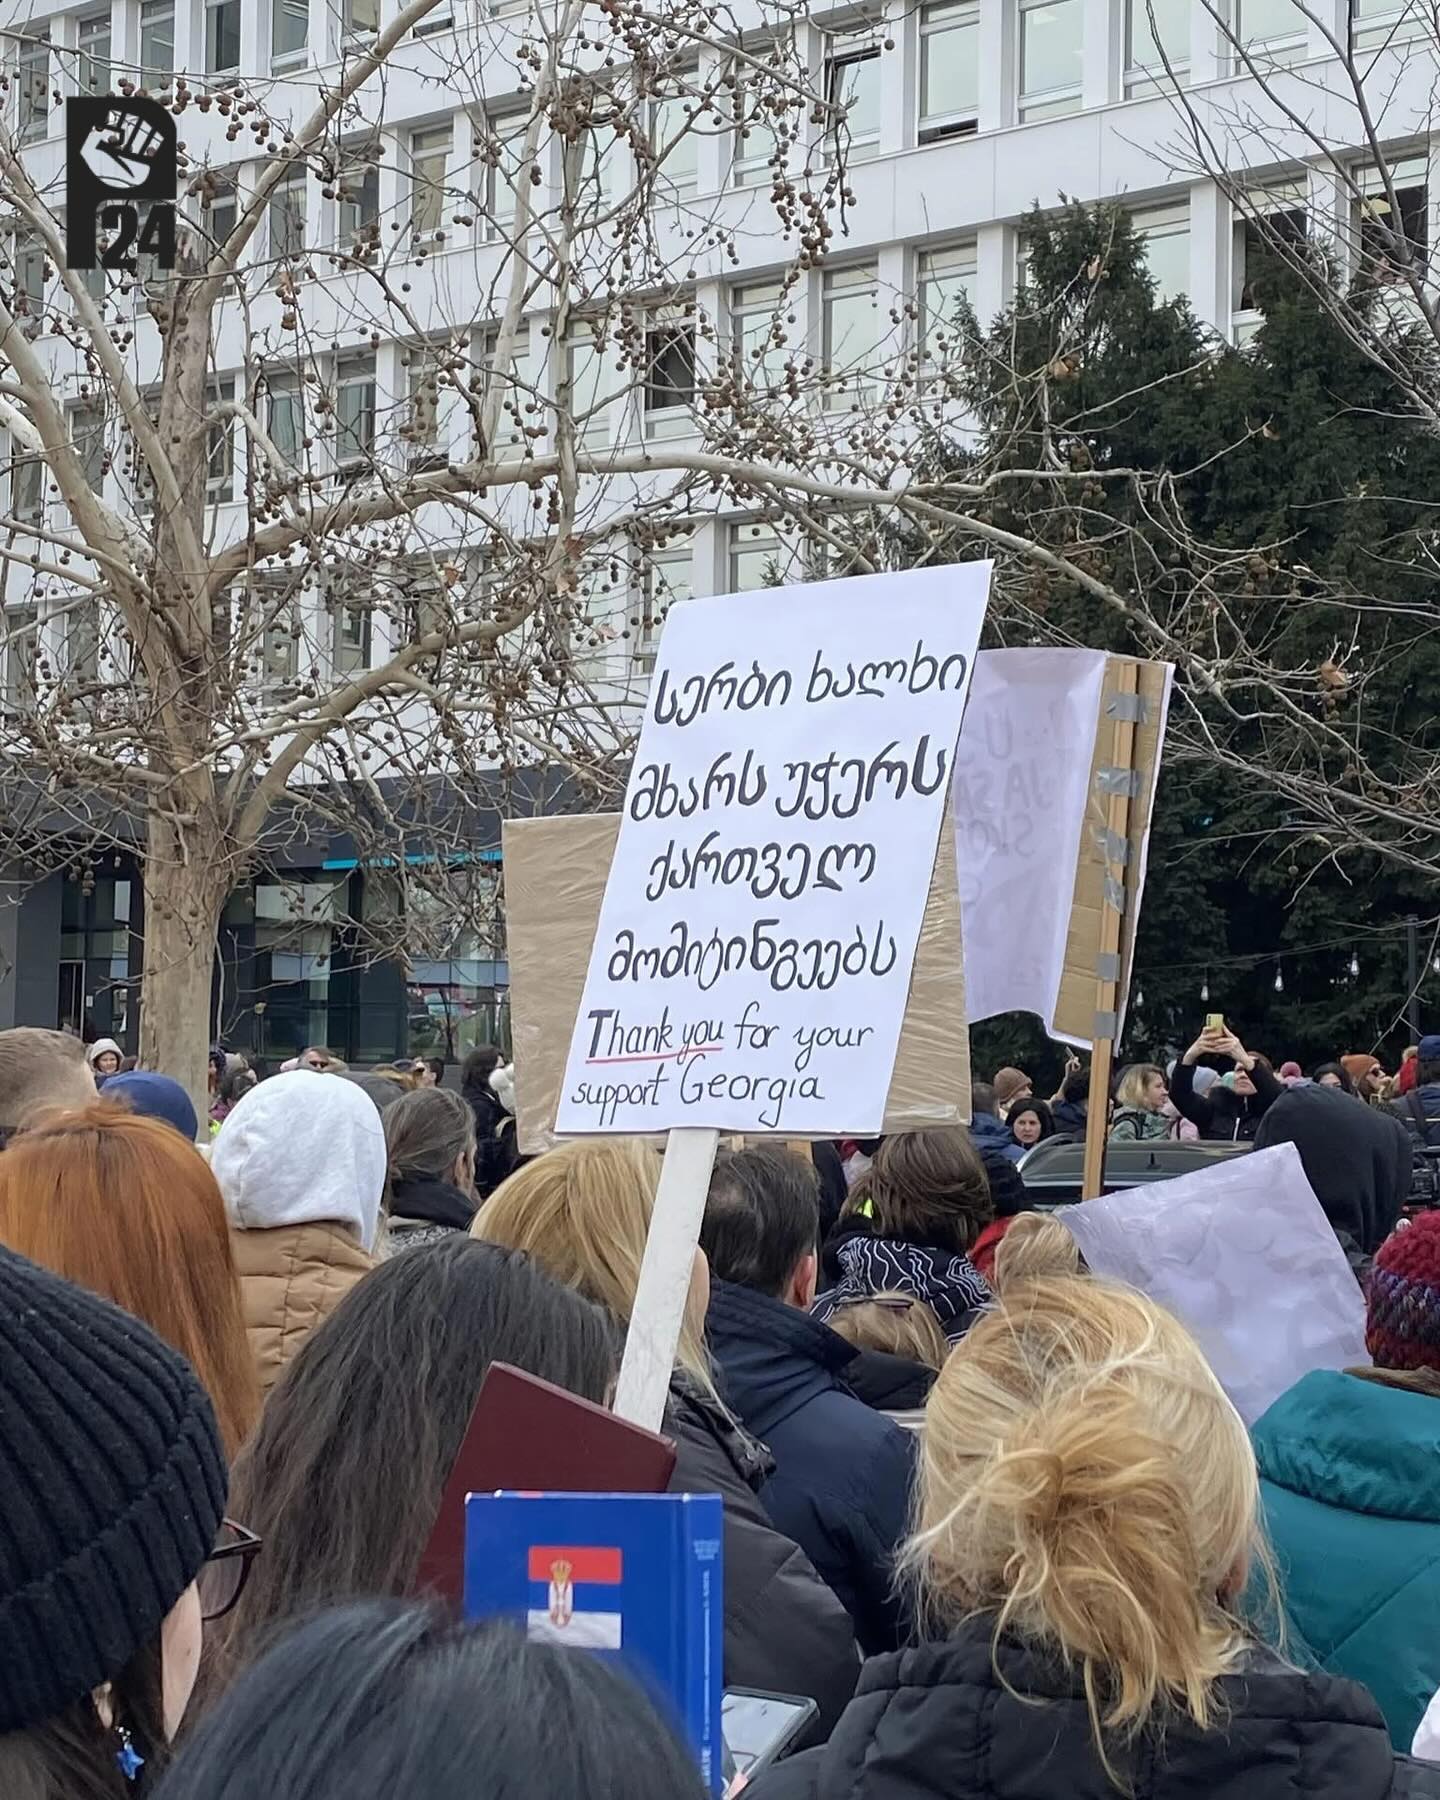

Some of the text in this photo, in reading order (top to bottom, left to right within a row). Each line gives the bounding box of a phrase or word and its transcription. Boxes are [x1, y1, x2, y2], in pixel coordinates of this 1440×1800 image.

[654, 639, 968, 727] სერბი ხალხი
[630, 749, 768, 822] მხარს
[774, 734, 948, 821] უჭერს
[645, 830, 876, 902] ქართველ
[607, 918, 897, 992] მომიტინგეებს
[587, 1001, 874, 1074] Thank you for your
[571, 1053, 826, 1129] support Georgia
